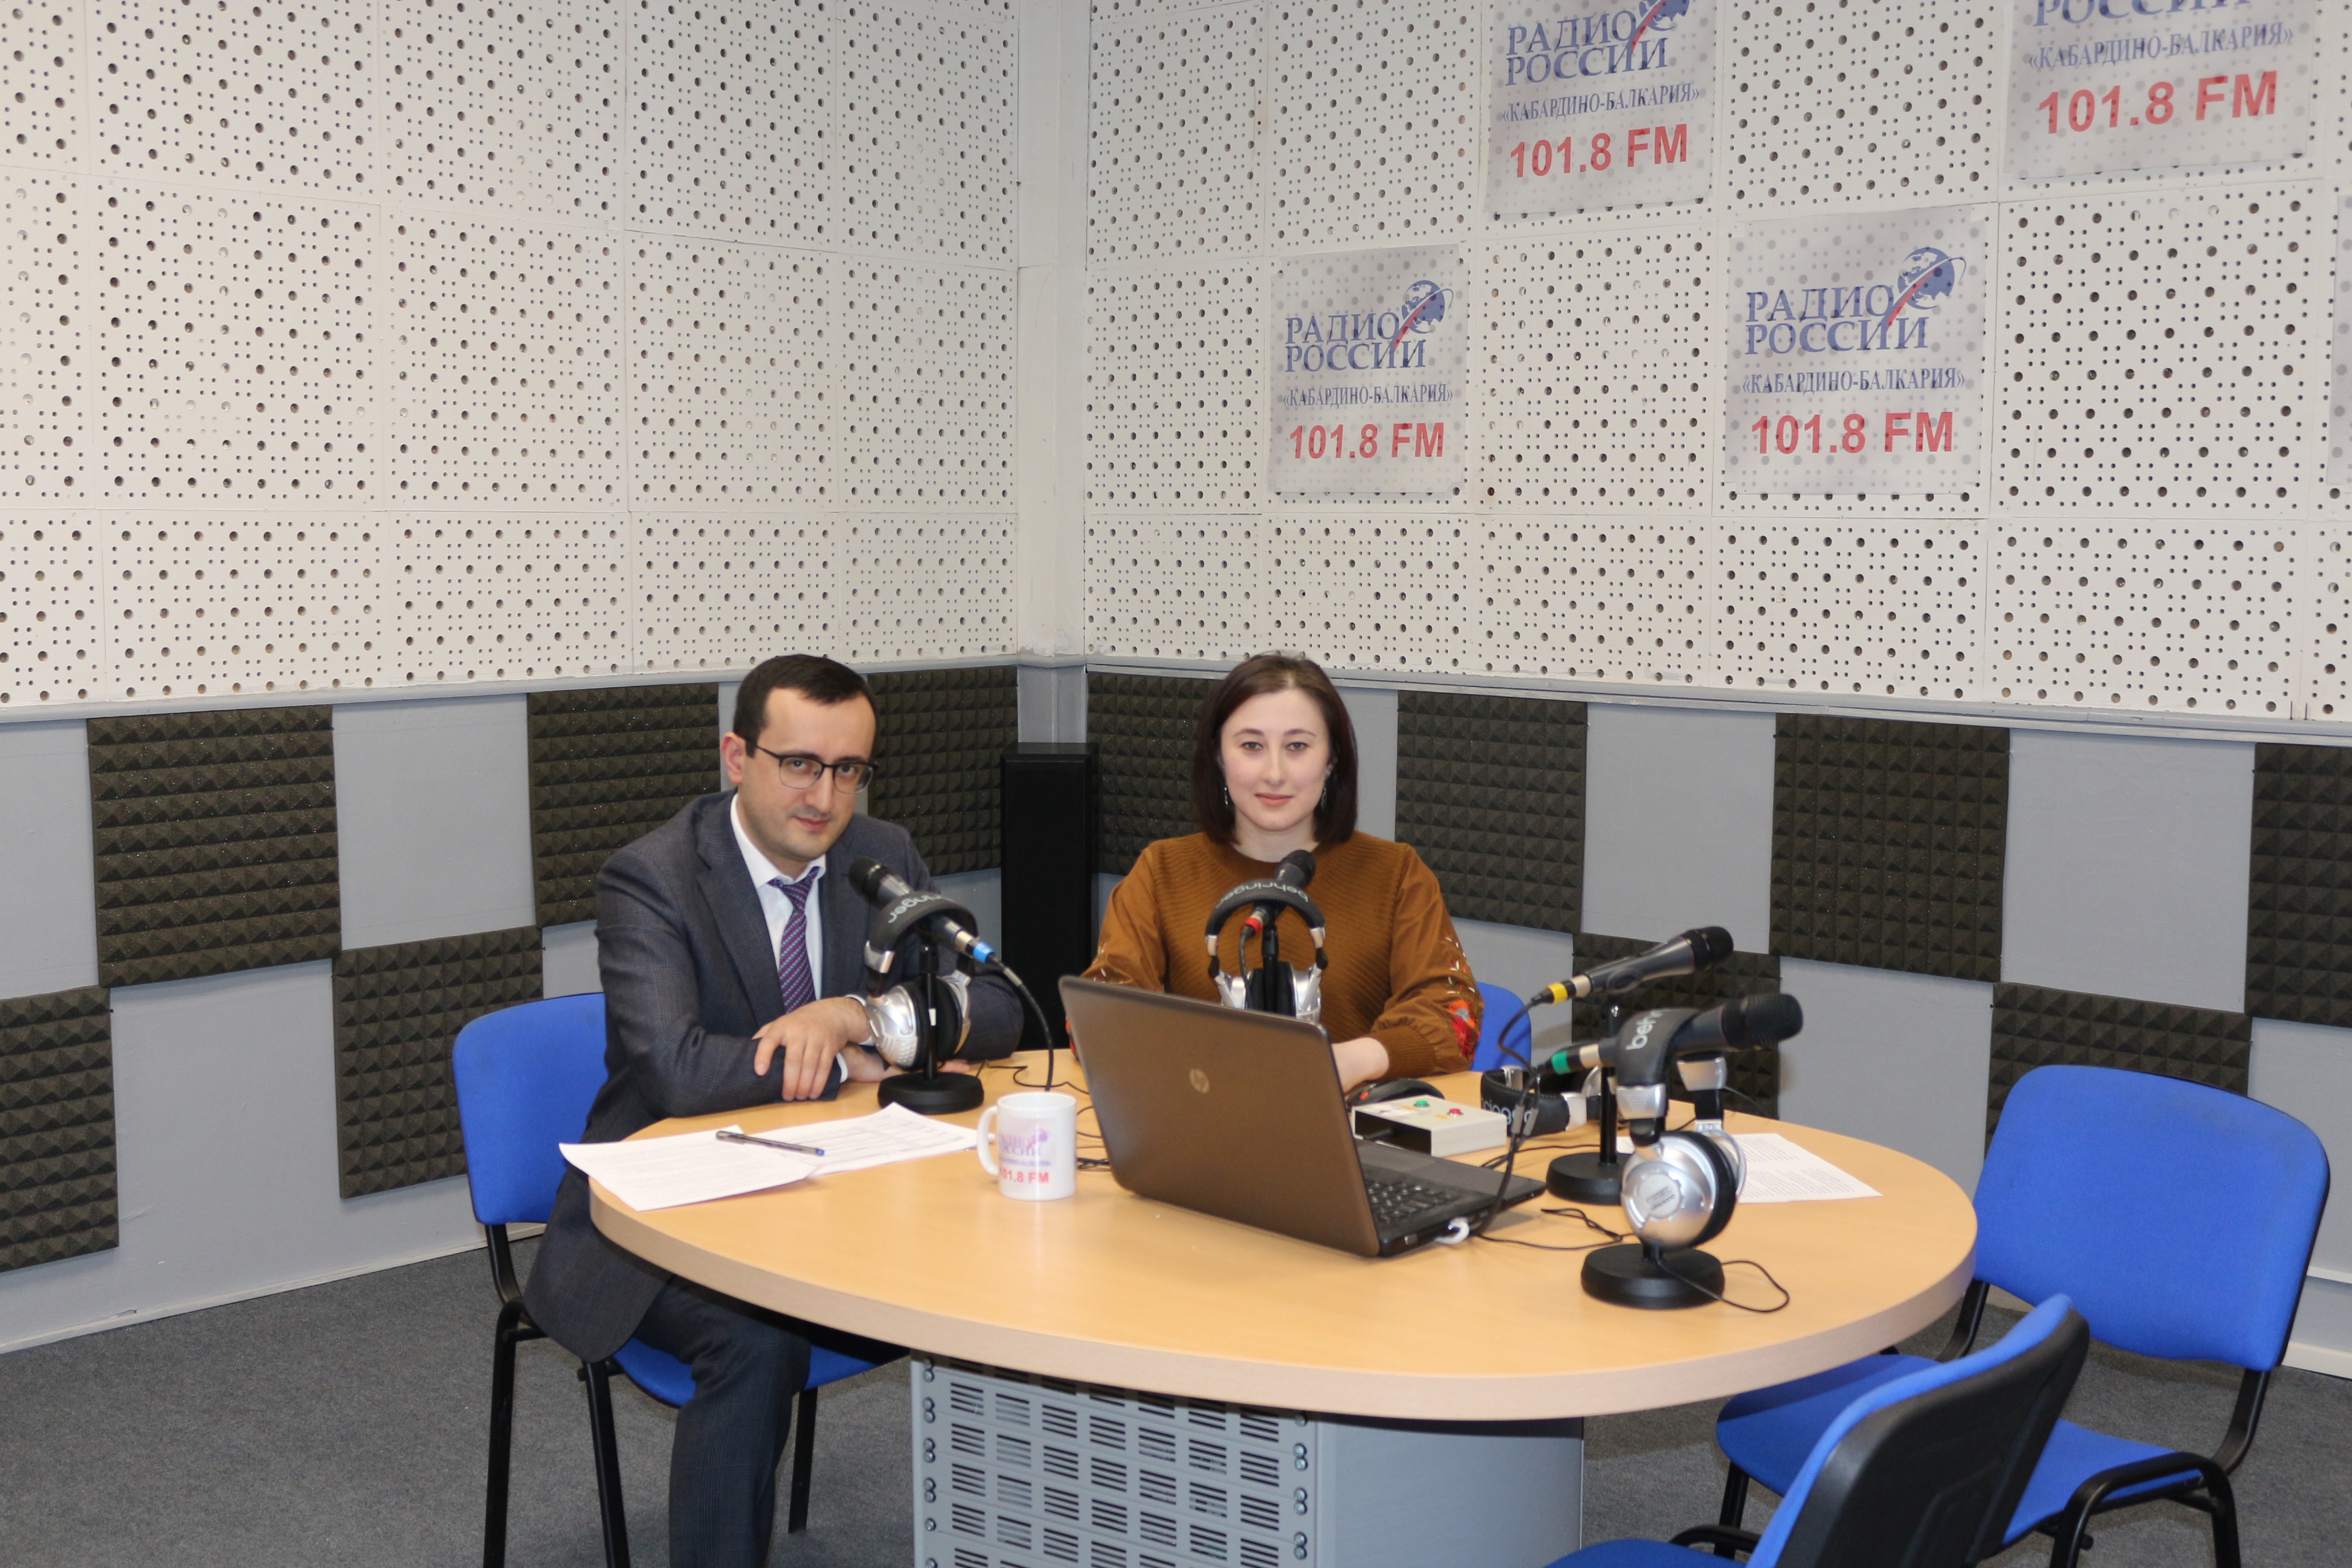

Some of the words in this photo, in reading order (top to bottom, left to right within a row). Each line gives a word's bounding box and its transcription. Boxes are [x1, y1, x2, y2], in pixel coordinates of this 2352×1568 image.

[1506, 10, 1636, 56] РАДИО
[2028, 22, 2294, 69] «КАБАРДИНО-БАЛКАРИЯ»
[1505, 37, 1668, 86] РОССИИ
[1503, 83, 1700, 122] «КАБАРДИНО-БАЛКАРИЯ»
[2039, 81, 2174, 134] 101.8
[2195, 71, 2278, 121] FM
[1510, 133, 1612, 178] 101.8
[1627, 124, 1687, 167] FM
[1746, 284, 1895, 323] РАДИО
[1285, 312, 1400, 344] РАДИО
[1744, 316, 1929, 355] РОССИИ
[1285, 340, 1426, 372] РОССИИ
[1283, 384, 1453, 408] «КАБАРДИНО-БАЛКАРИЯ»
[1742, 368, 1965, 396] «КАБАРДИНО-БАЛКАРИЯ»
[1290, 423, 1377, 459] 101.8
[1391, 422, 1444, 457] FM
[1751, 413, 1866, 454] 101.8
[1884, 411, 1953, 453] FM
[1215, 883, 1308, 909] behringer
[1028, 1171, 1050, 1184] FM
